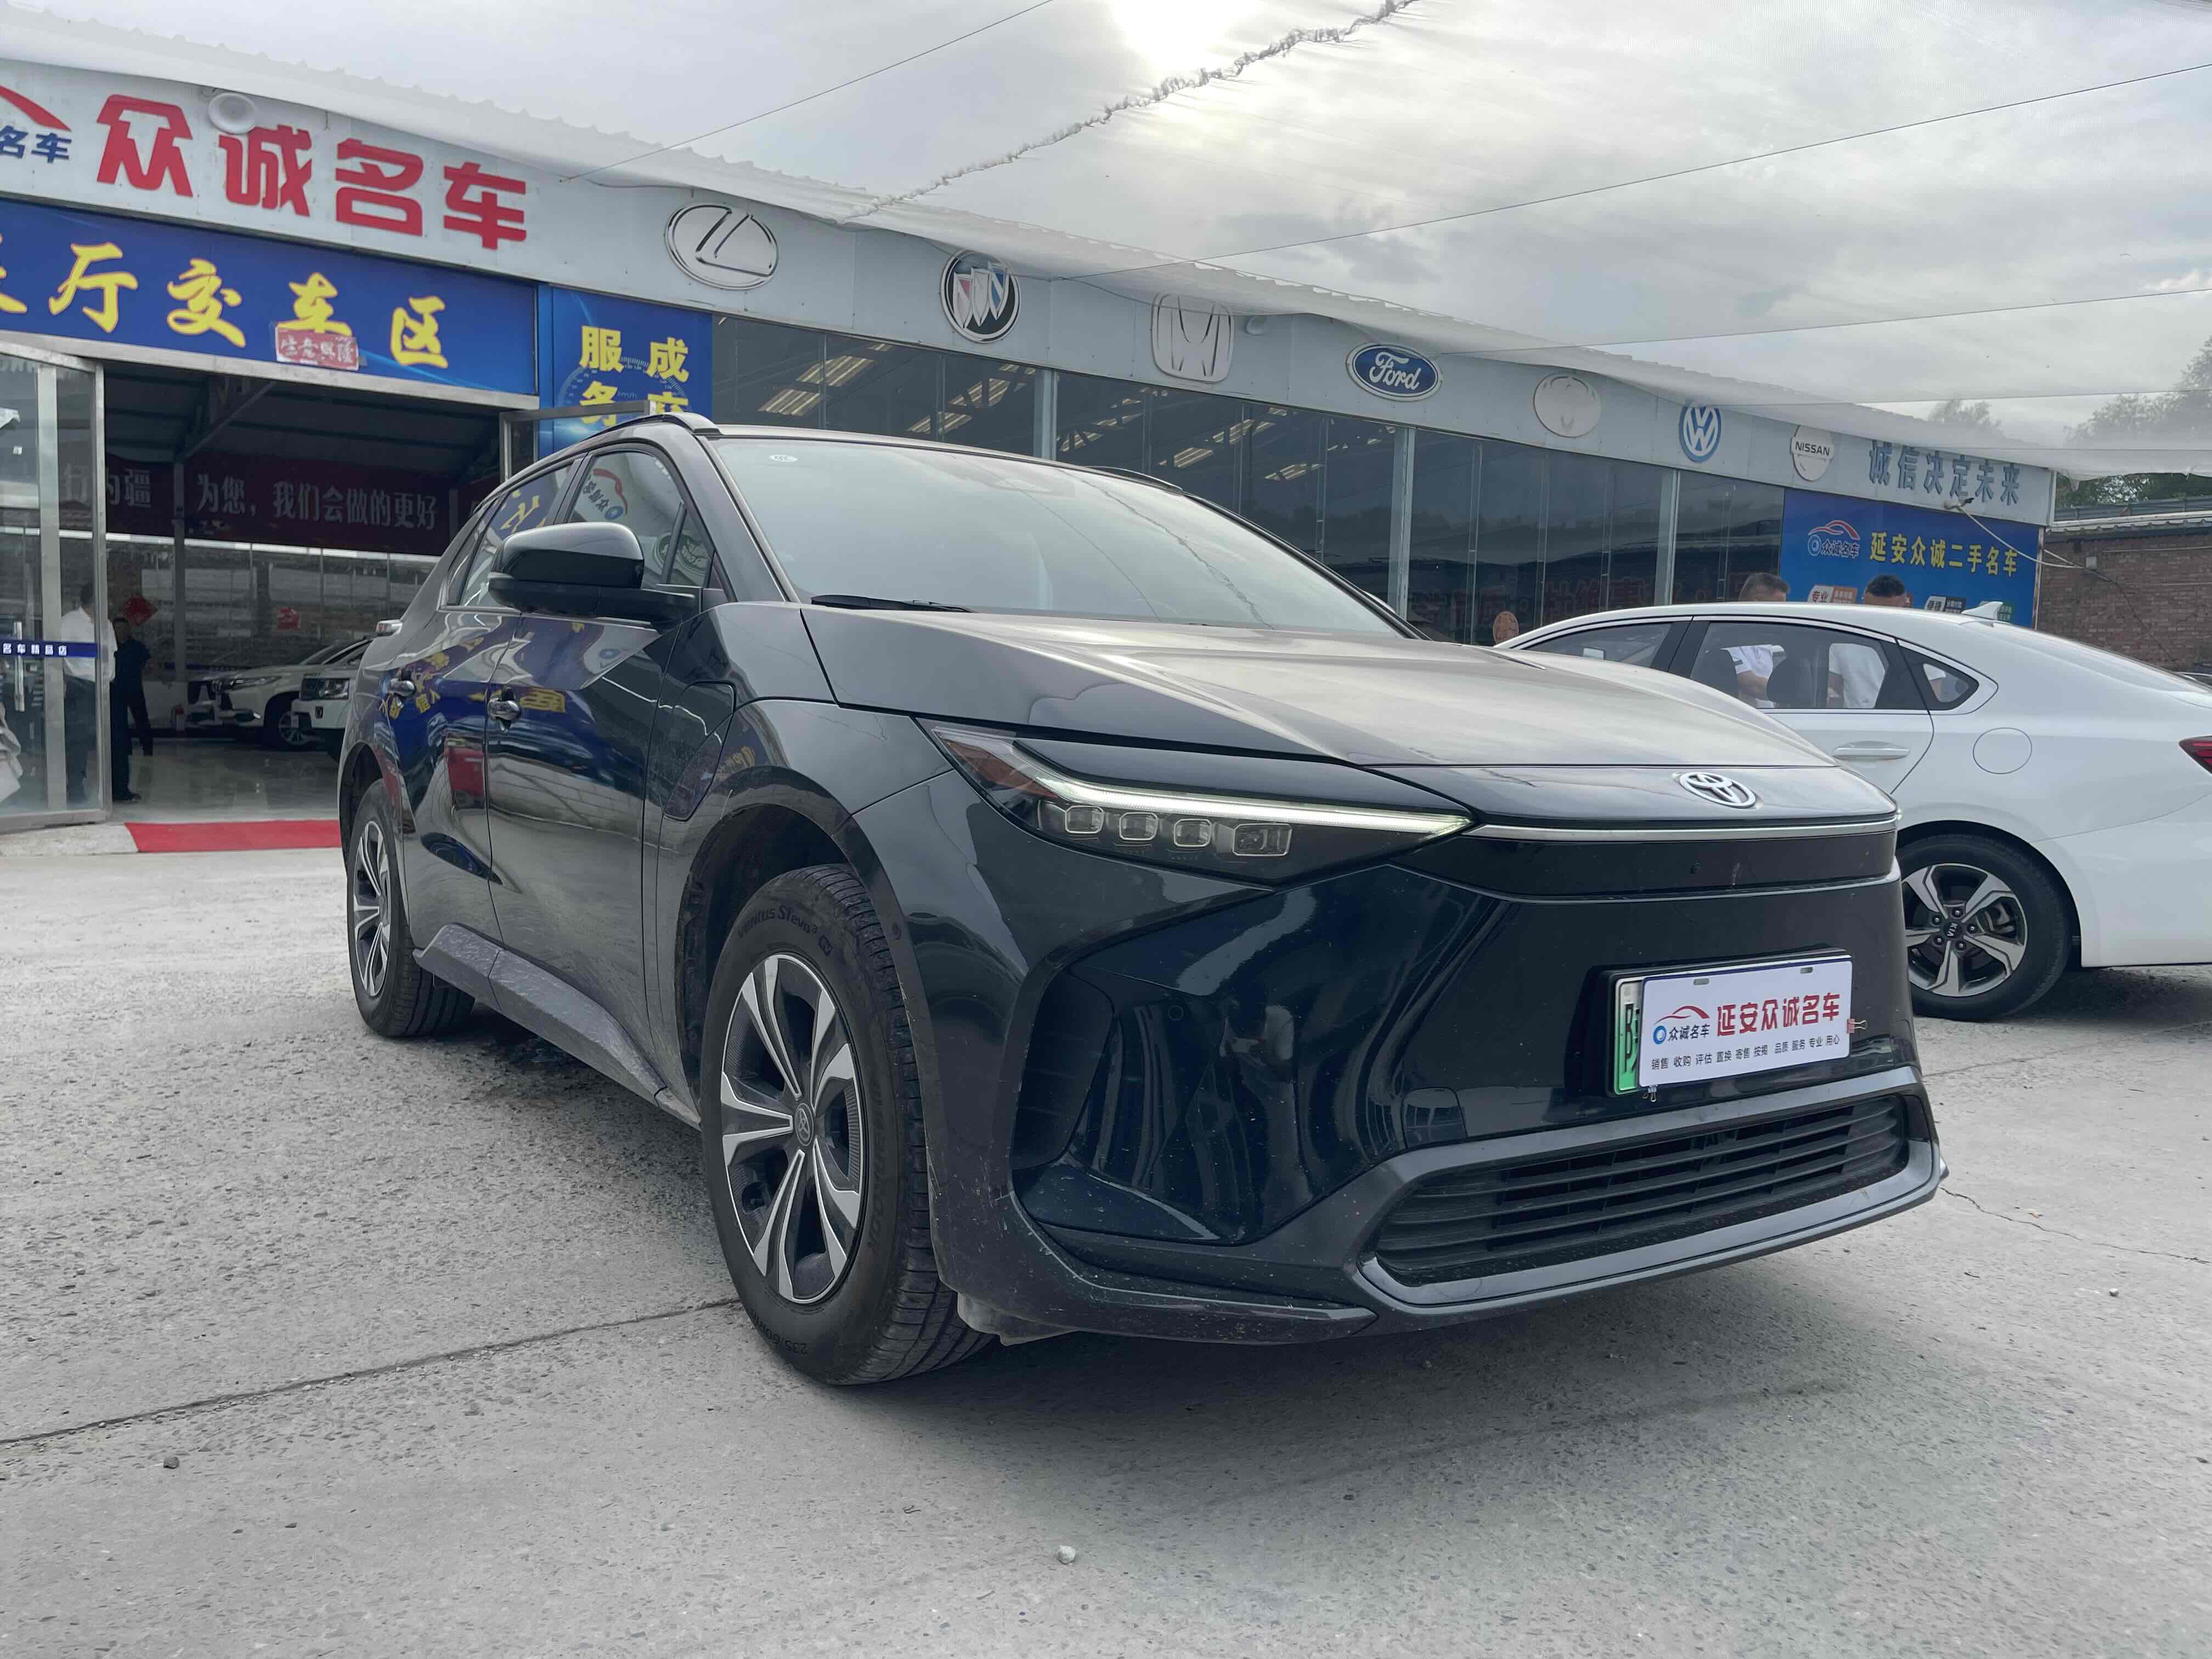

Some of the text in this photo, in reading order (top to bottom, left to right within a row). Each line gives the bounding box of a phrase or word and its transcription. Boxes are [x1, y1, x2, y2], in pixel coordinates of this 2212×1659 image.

[96, 94, 527, 250] 众诚名车
[0, 235, 448, 369] 厅交车区
[1369, 351, 1422, 391] Ford
[1795, 441, 1830, 457] NISSAN
[1869, 439, 2021, 506] 诚信决定未来
[1869, 531, 2019, 578] 延安众诚二手名车
[1667, 1023, 1711, 1041] 众诚名车
[1717, 992, 1840, 1037] 延安众诚名车
[1674, 1055, 1691, 1068] 收购
[1696, 1053, 1712, 1065] 评估
[1775, 1041, 1789, 1054] 品质
[1792, 1039, 1805, 1051] 服务
[1808, 1036, 1823, 1048] 专业
[1826, 1034, 1840, 1046] 用心
